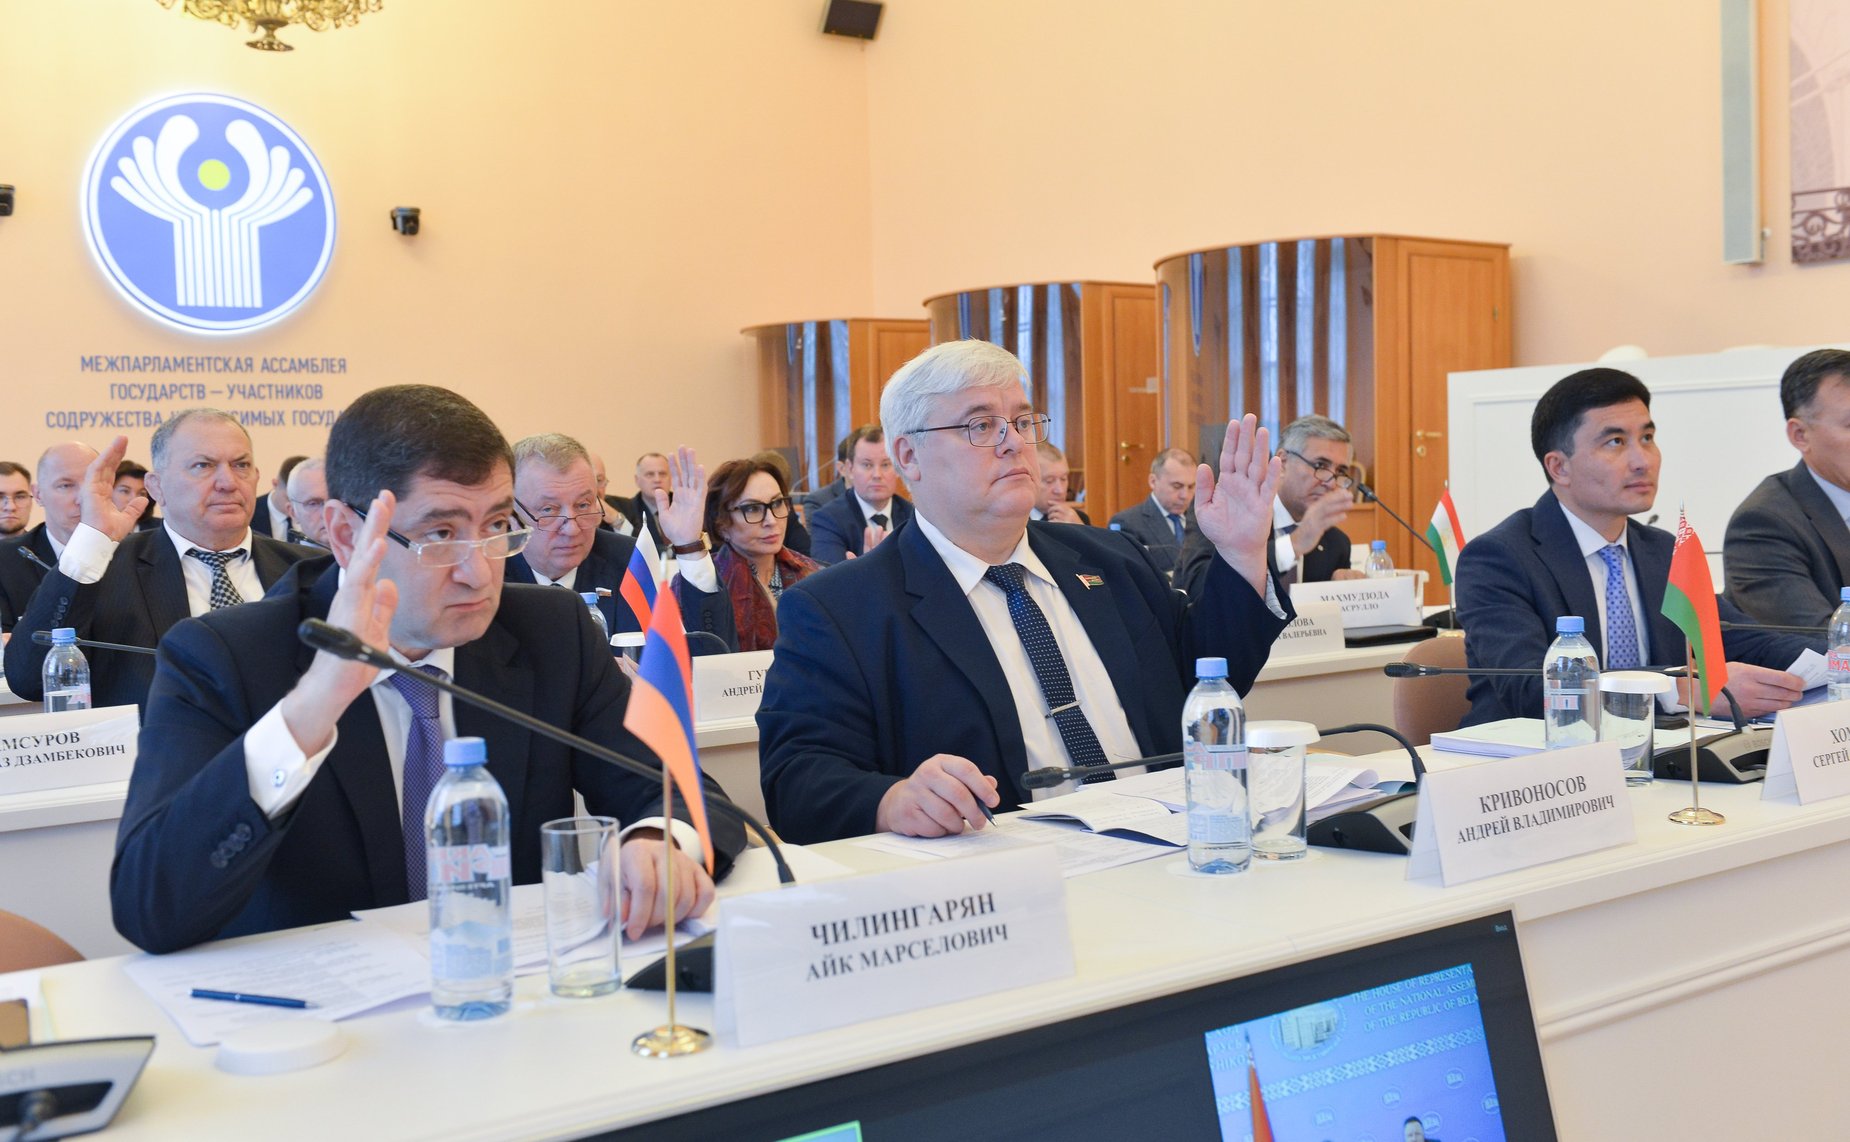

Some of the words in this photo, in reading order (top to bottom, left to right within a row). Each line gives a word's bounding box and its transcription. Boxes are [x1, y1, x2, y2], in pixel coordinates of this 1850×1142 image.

[80, 356, 253, 373] МЕЖПАРЛАМЕНТСКАЯ
[261, 357, 347, 373] АССАМБЛЕЯ
[110, 383, 206, 402] ГОСУДАРСТВ
[227, 383, 323, 401] УЧАСТНИКОВ
[46, 411, 162, 429] СОДРУЖЕСТВА
[292, 410, 343, 428] ГОСУД
[1342, 604, 1378, 612] АСРУЛЛО
[1286, 618, 1314, 629] ЛОВА
[722, 683, 763, 697] АНДРЕЙ
[0, 731, 81, 751] МСУРОВ
[14, 744, 126, 768] ДЗАМБЕКОВИЧ
[1812, 747, 1850, 768] СЕРГЕЙ
[1478, 775, 1587, 814] КРИВОНОСОВ
[1458, 816, 1511, 843] АНДРЕЙ
[1513, 794, 1616, 831] ВЛАДИМИРОВИЧ
[811, 892, 996, 946] ЧИЛИНГАРЯН
[806, 953, 854, 982] АЙК
[860, 923, 1009, 971] МАРСЕЛОВИЧ
[1372, 983, 1404, 998] HOUSE
[1404, 978, 1417, 989] OF
[1364, 1004, 1377, 1016] OF
[1379, 1000, 1398, 1013] THE
[1399, 988, 1444, 1006] NATIONAL
[1363, 1021, 1377, 1033] OF
[1378, 1016, 1398, 1029] THE
[1399, 1003, 1442, 1022] REPUBLIC
[1443, 998, 1456, 1011] OF
